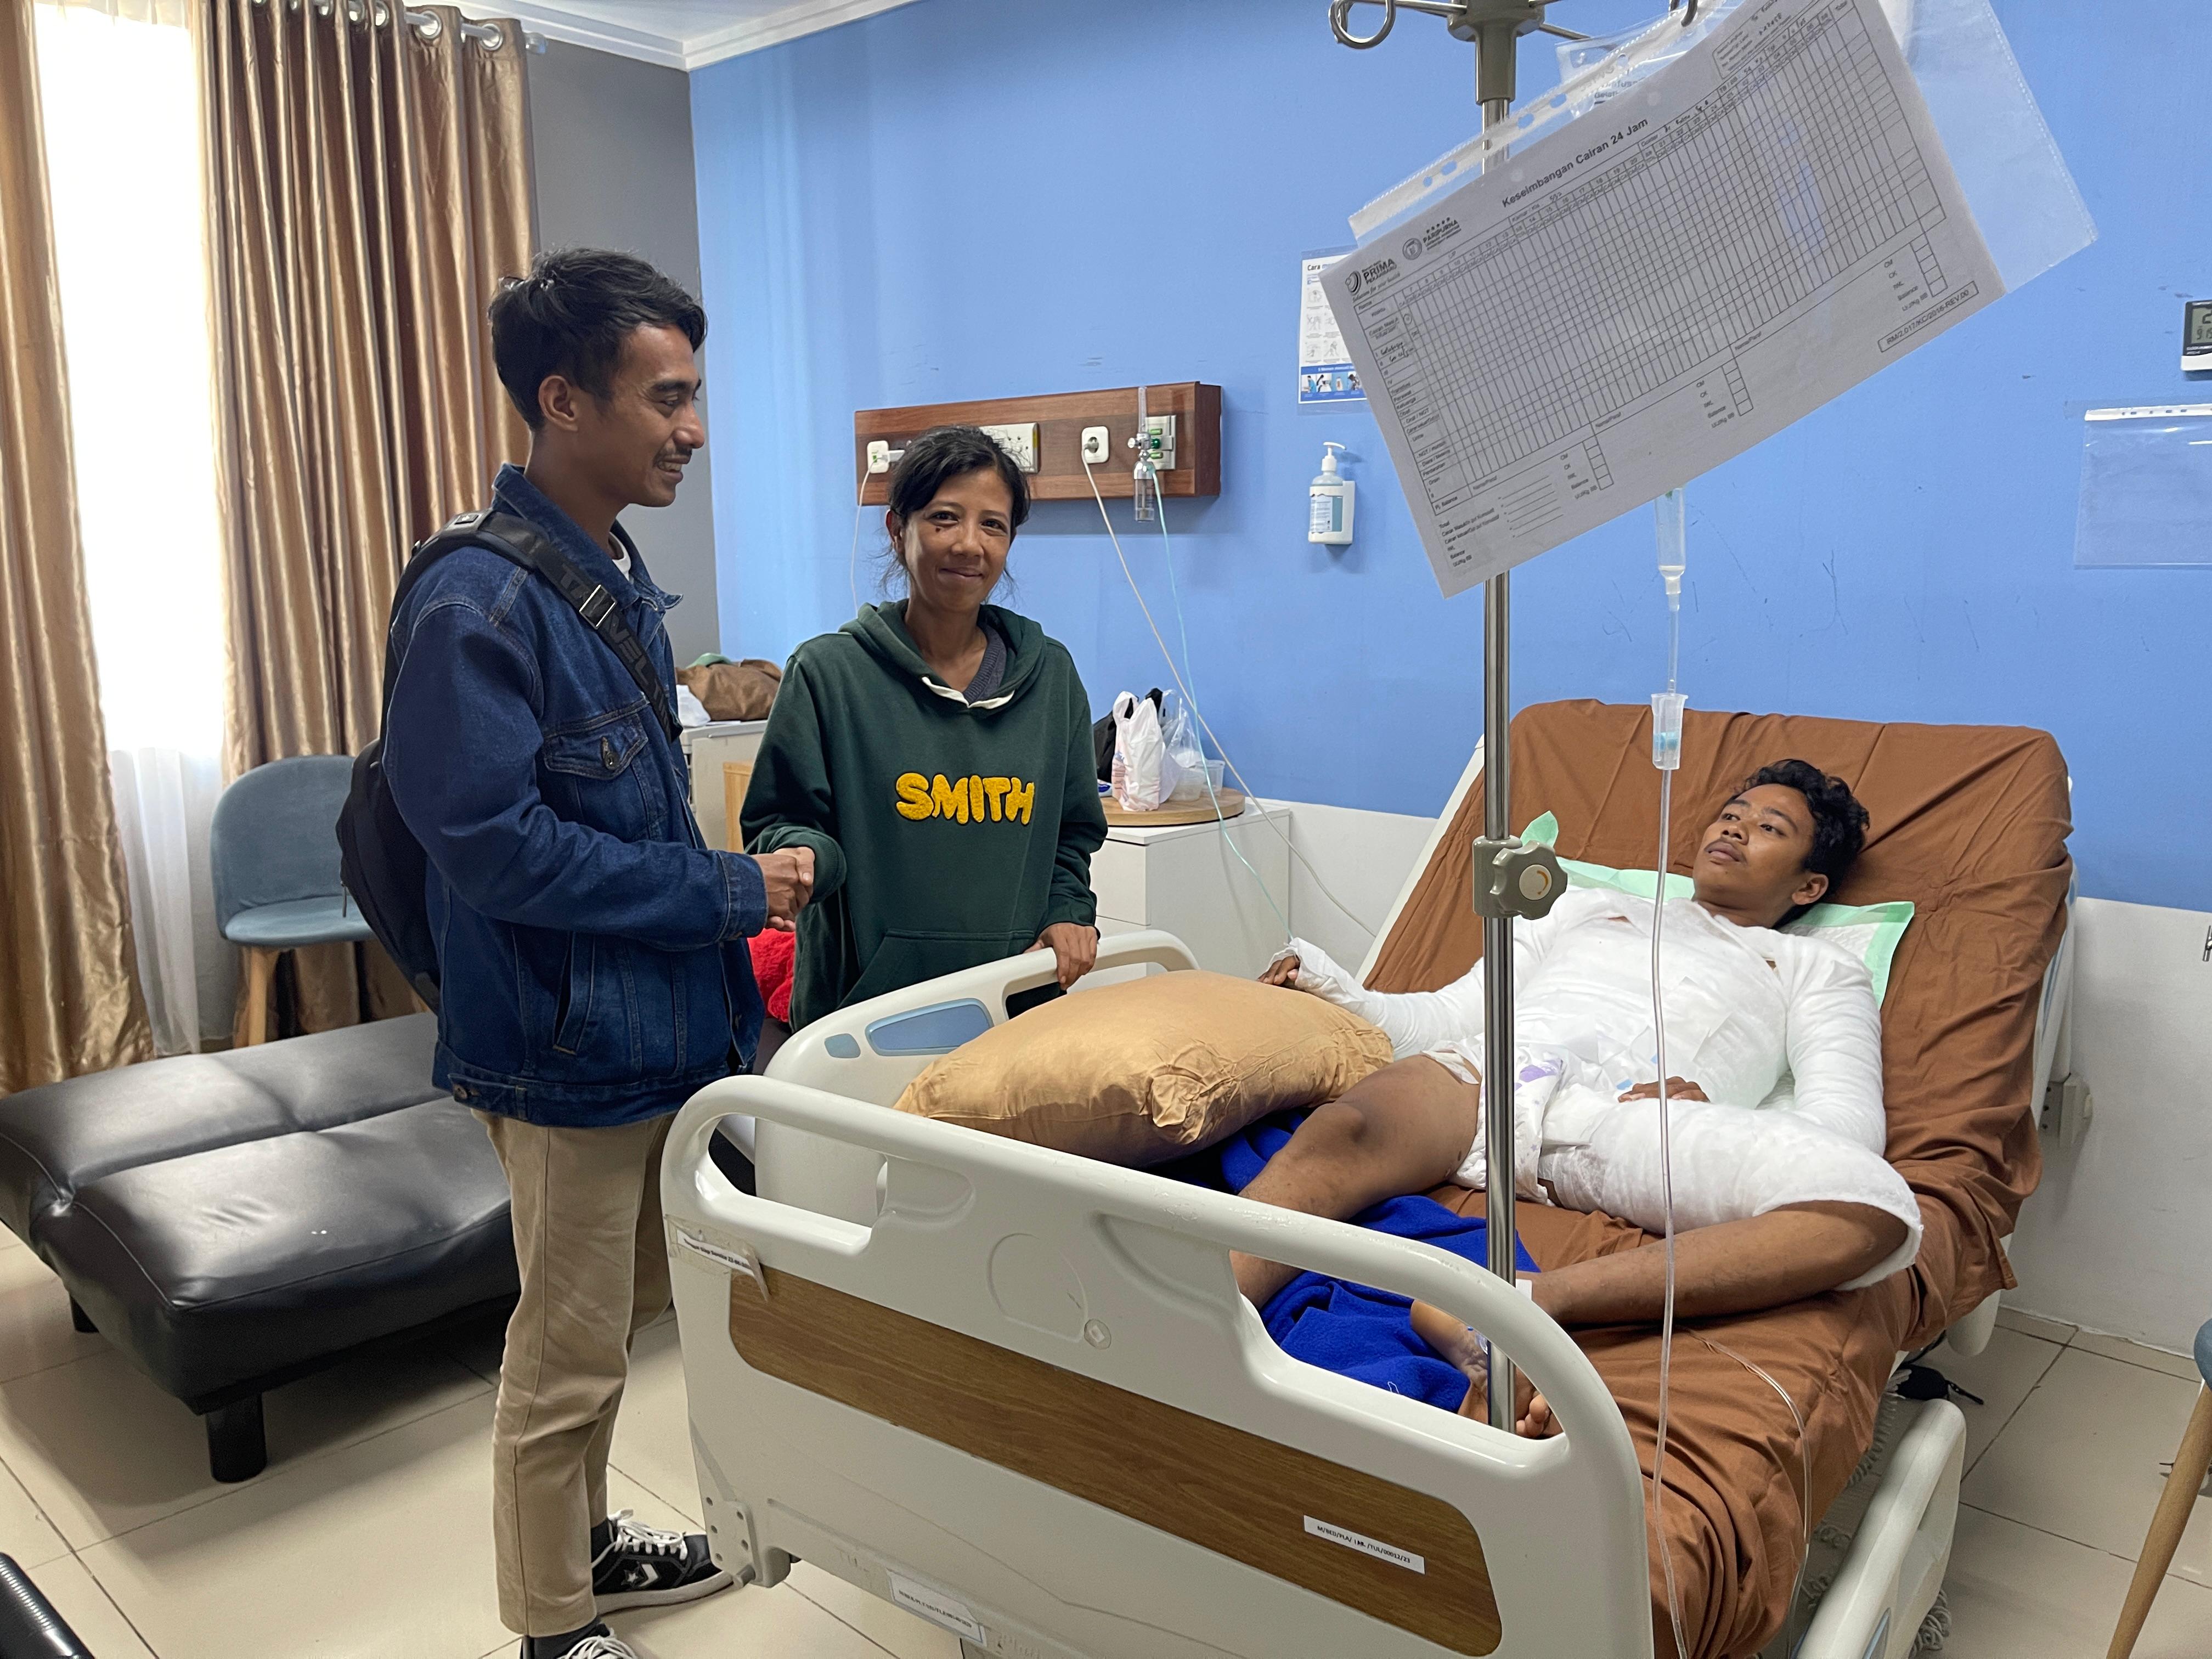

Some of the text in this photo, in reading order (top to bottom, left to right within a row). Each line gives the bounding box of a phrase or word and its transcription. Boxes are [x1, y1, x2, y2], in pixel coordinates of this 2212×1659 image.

[1502, 162, 1573, 206] Keseimbangan
[1575, 141, 1608, 163] Cairan
[1610, 132, 1623, 144] 24
[1625, 119, 1647, 135] Jam
[1363, 258, 1394, 279] PRIMA
[896, 772, 1035, 825] SMITH
